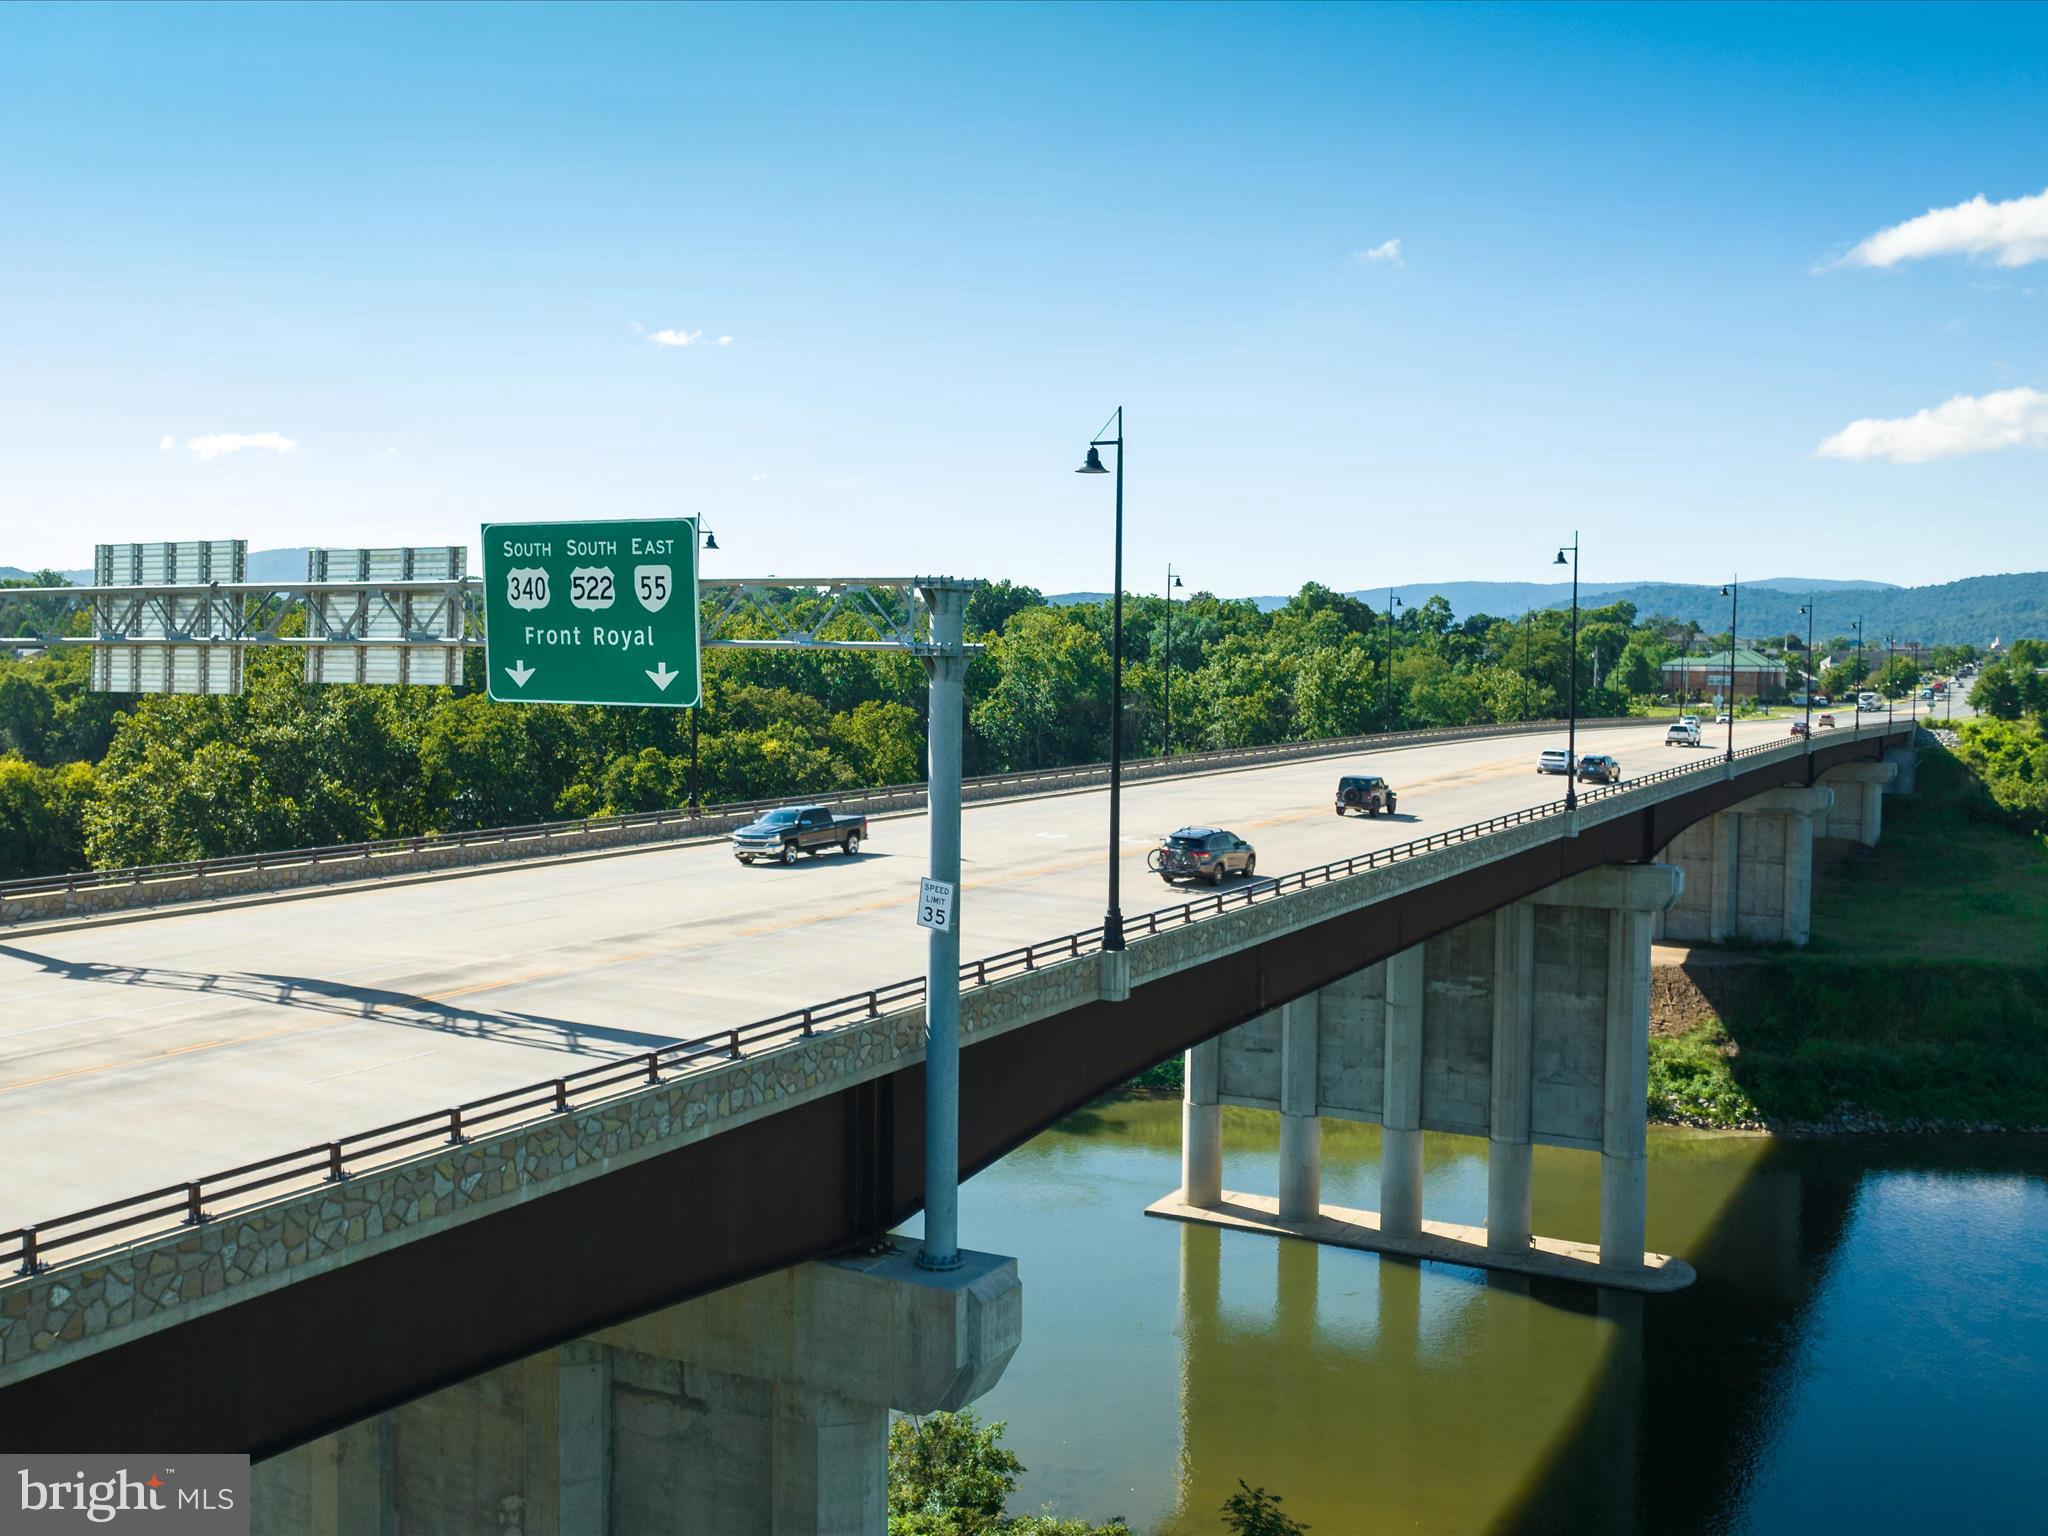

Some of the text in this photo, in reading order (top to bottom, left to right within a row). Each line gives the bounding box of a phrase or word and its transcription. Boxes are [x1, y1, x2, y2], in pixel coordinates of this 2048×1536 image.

[631, 537, 674, 555] EAST
[510, 576, 667, 601] 340 522 55
[525, 626, 654, 651] Front Royal
[924, 883, 950, 896] SPEED
[926, 895, 946, 906] LIMIT
[923, 906, 946, 925] 35
